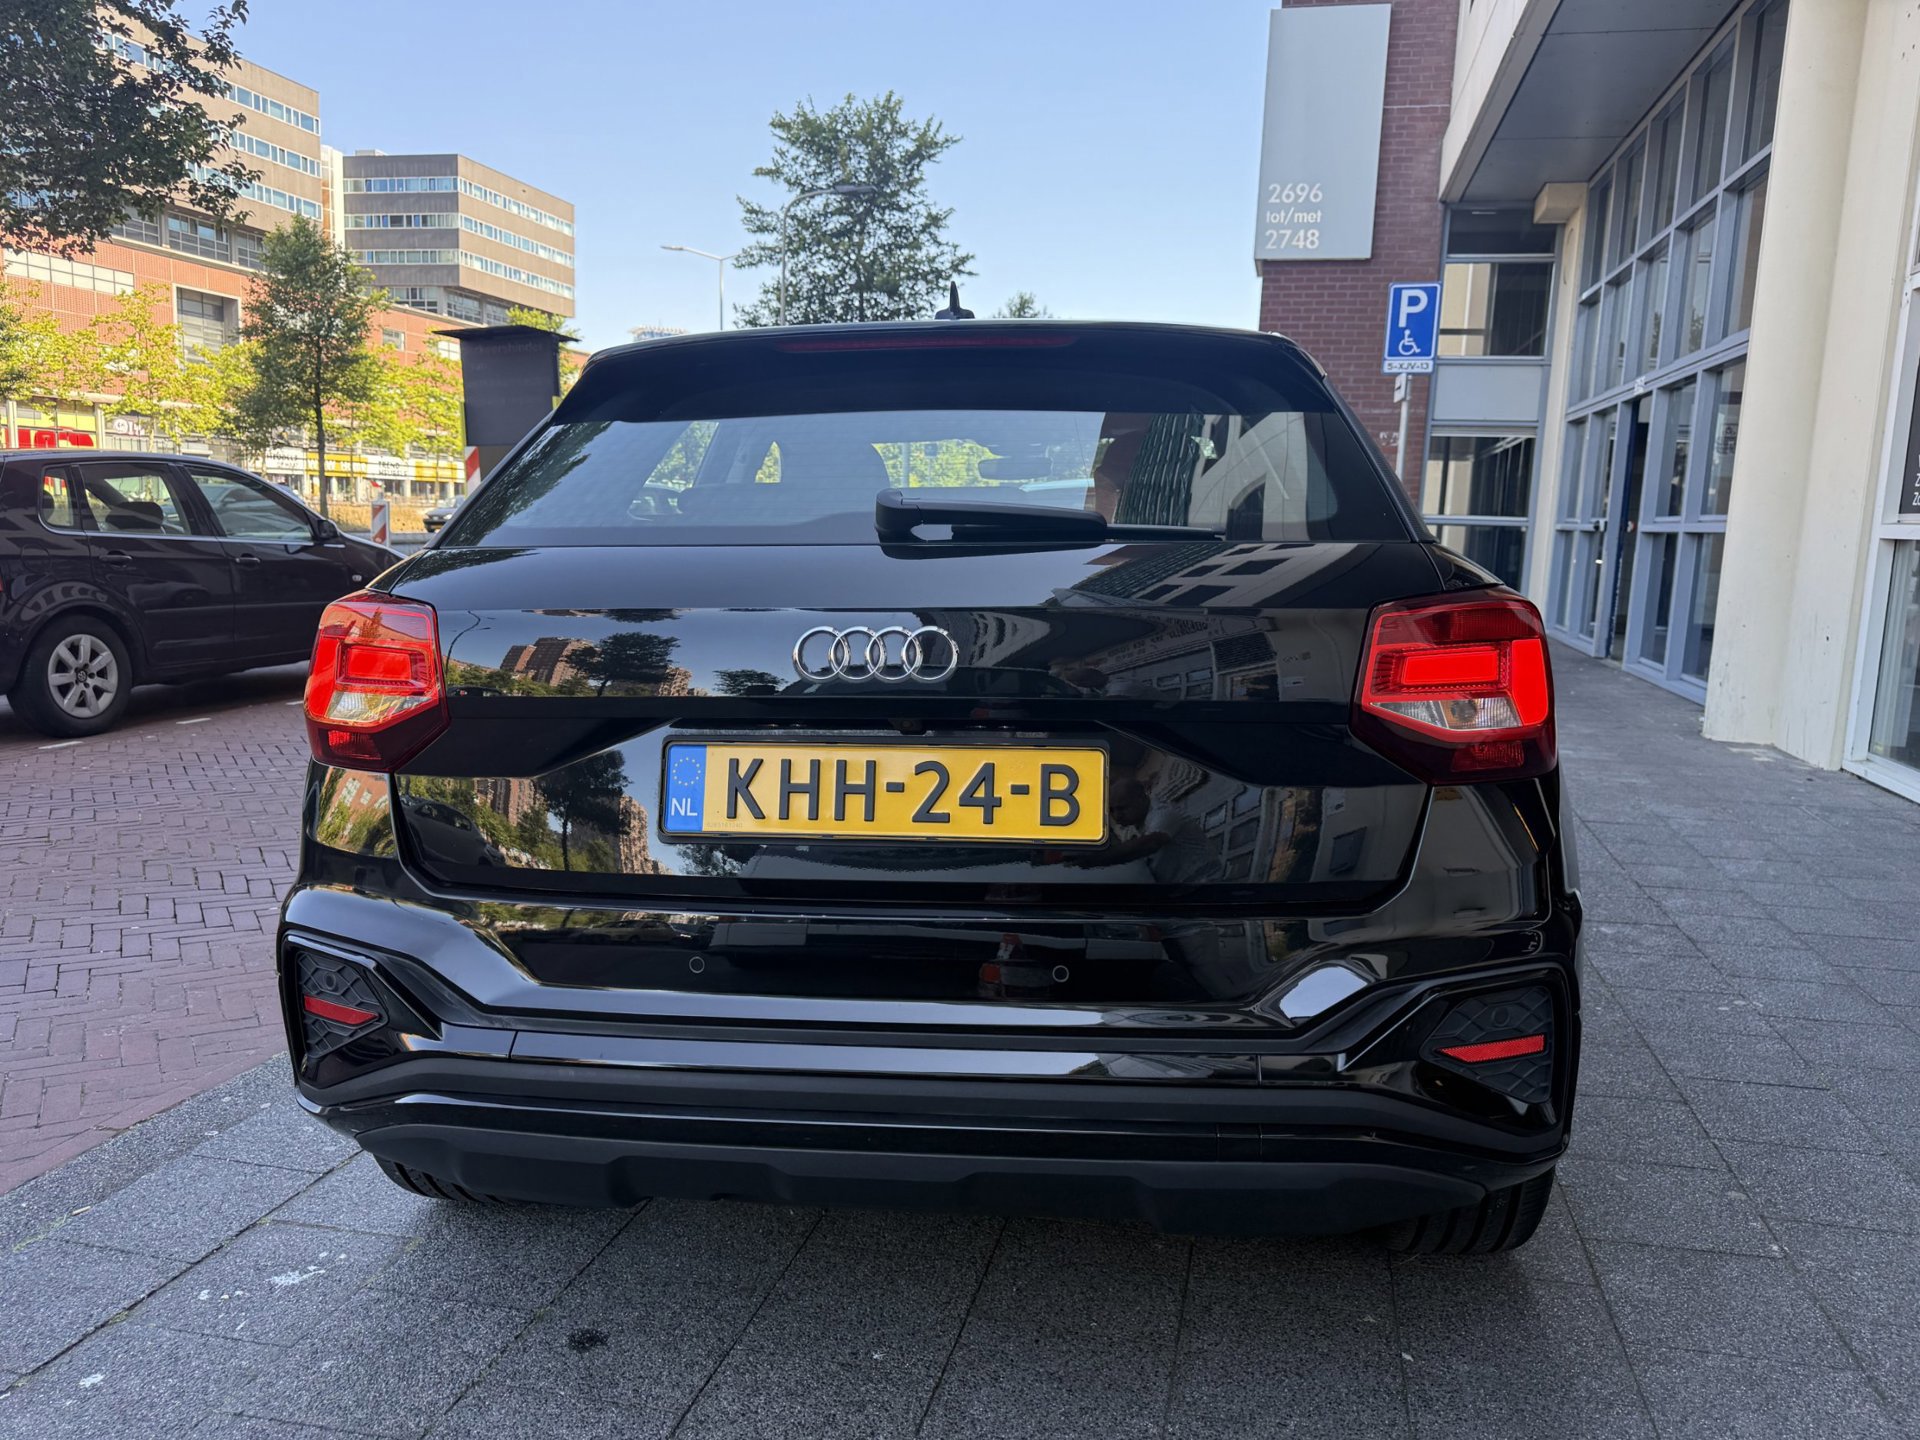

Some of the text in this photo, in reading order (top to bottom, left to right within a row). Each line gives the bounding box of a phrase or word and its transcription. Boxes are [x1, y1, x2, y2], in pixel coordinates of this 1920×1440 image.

[1268, 182, 1323, 203] 2696
[1266, 207, 1322, 225] tot/met
[1265, 229, 1320, 249] 2748
[1398, 289, 1428, 328] P
[726, 757, 1080, 826] KHH-24-B
[671, 797, 698, 816] NL
